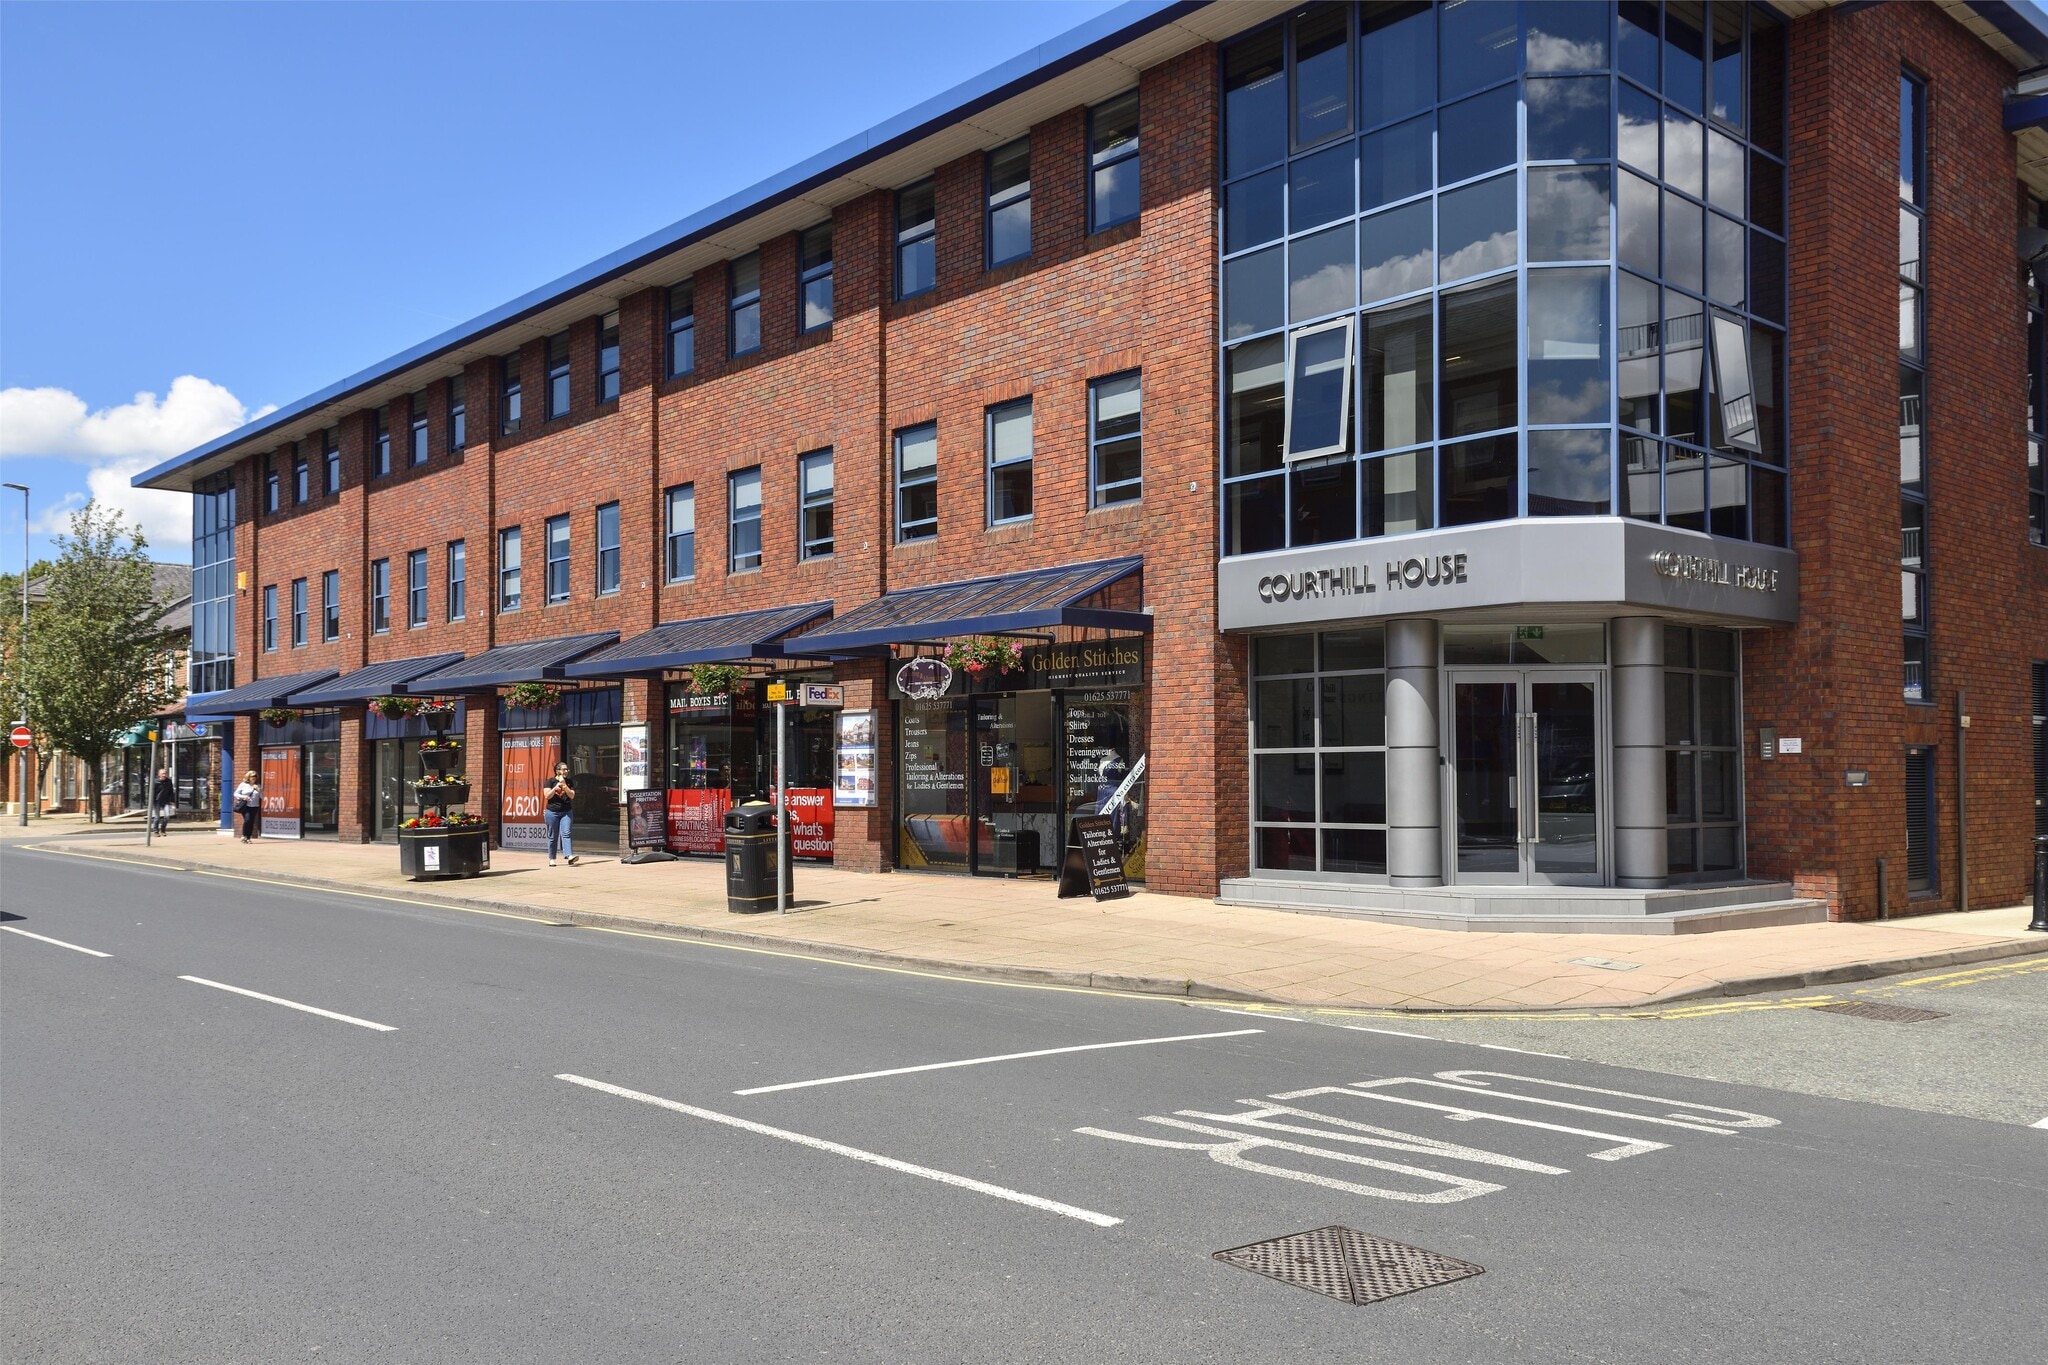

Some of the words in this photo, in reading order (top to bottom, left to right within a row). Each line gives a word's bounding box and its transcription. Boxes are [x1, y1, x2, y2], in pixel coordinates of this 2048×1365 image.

[1258, 565, 1376, 598] COURTHILL
[1386, 553, 1467, 584] HOUSE
[1031, 651, 1080, 672] Golden
[1083, 646, 1139, 668] Stitches
[809, 687, 840, 700] FedEx
[1083, 692, 1105, 701] 01625
[1106, 690, 1131, 700] 537771
[670, 698, 688, 709] MAIL
[690, 696, 711, 707] BOXES
[915, 702, 932, 711] 01625
[933, 700, 953, 710] 537771
[977, 713, 998, 722] Tailoring
[1069, 708, 1085, 718] Tops
[904, 716, 920, 725] Coats
[1069, 720, 1088, 730] Shirts
[904, 728, 928, 736] Trousers
[1069, 734, 1095, 743] Dresses
[504, 740, 528, 748] COURTHILL
[904, 740, 920, 748] Jeans
[904, 751, 917, 761] Zips
[1069, 747, 1112, 759] Eveningwear
[514, 763, 525, 773] LET
[905, 763, 938, 772] Professional
[1069, 759, 1099, 771] Wedding
[1100, 762, 1126, 770] resses
[905, 772, 930, 782] Tailoring
[934, 771, 964, 780] Alterations
[1069, 773, 1083, 783] Suit
[1084, 773, 1108, 783] Jackets
[914, 782, 931, 790] Ladies
[936, 781, 964, 790] Gentlemen
[1069, 787, 1084, 797] Furs
[263, 796, 285, 814] 2,620
[790, 795, 825, 807] answer
[505, 795, 540, 819] 2,620
[675, 820, 704, 830] PRINTING
[793, 822, 824, 836] what's
[506, 826, 527, 839] 01625
[1082, 831, 1106, 839] Tailoring
[1107, 828, 1113, 836] &
[793, 836, 833, 853] question
[1087, 838, 1114, 848] Alterations
[1098, 848, 1106, 856] for
[1092, 858, 1110, 867] Ladies
[1110, 856, 1116, 864] &
[1093, 867, 1120, 877] Gentlemen
[1094, 886, 1110, 896] 01625
[1111, 883, 1129, 893] 537771
